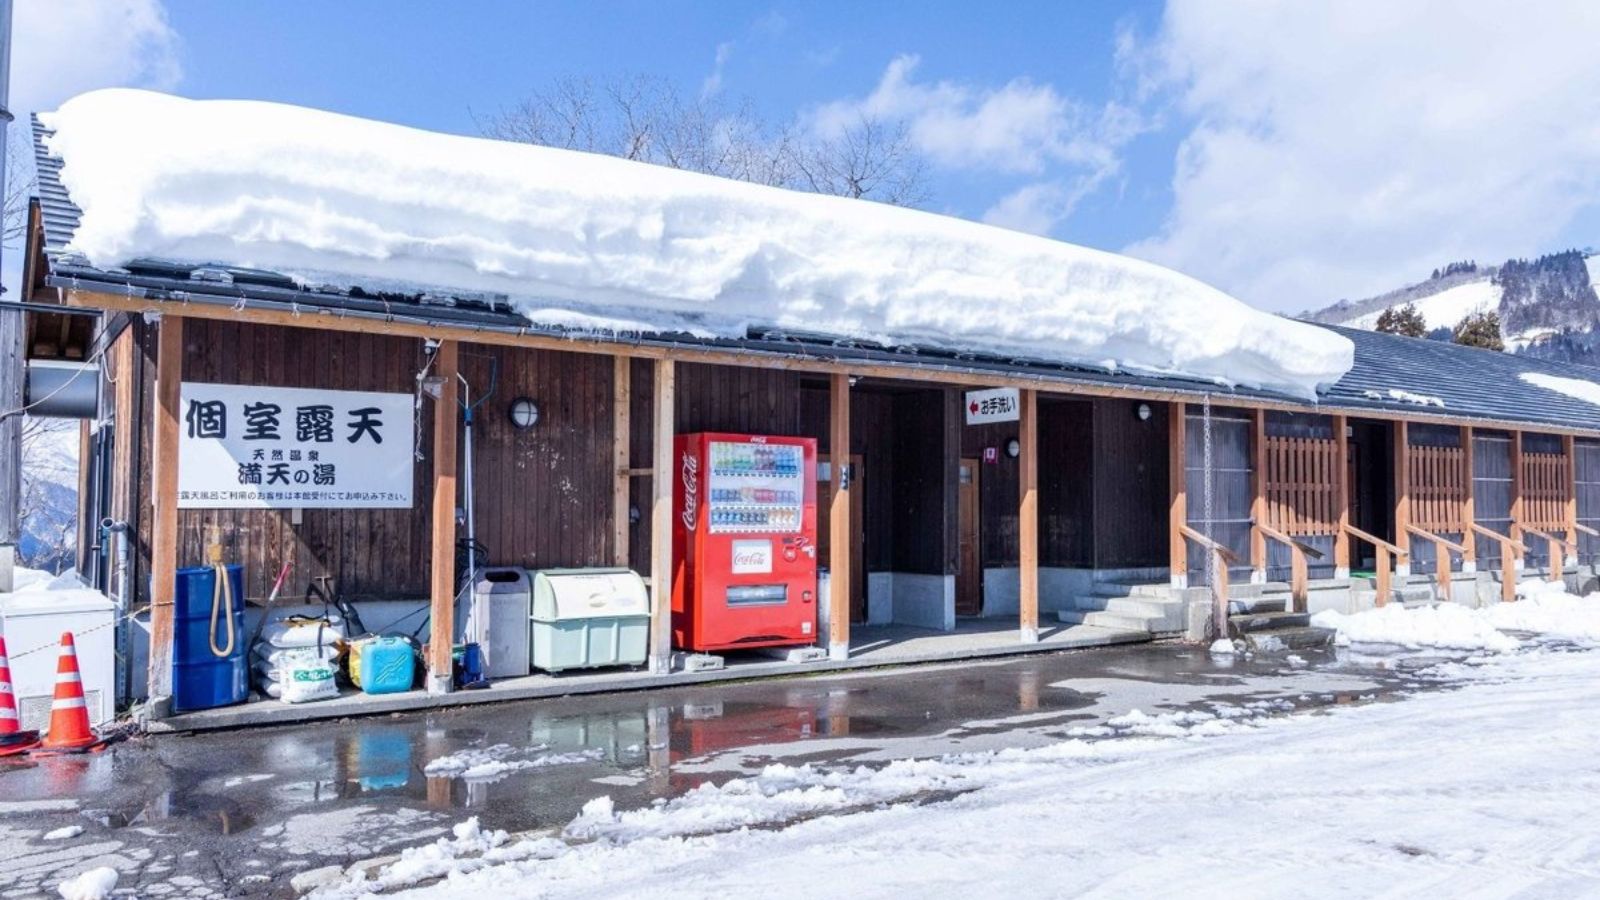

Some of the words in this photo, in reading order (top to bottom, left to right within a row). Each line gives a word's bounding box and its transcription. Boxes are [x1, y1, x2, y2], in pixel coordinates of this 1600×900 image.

[981, 397, 1016, 414] お手洗い
[185, 399, 384, 444] 個室露天
[253, 449, 320, 461] 天然温泉
[238, 462, 336, 485] 満天の湯
